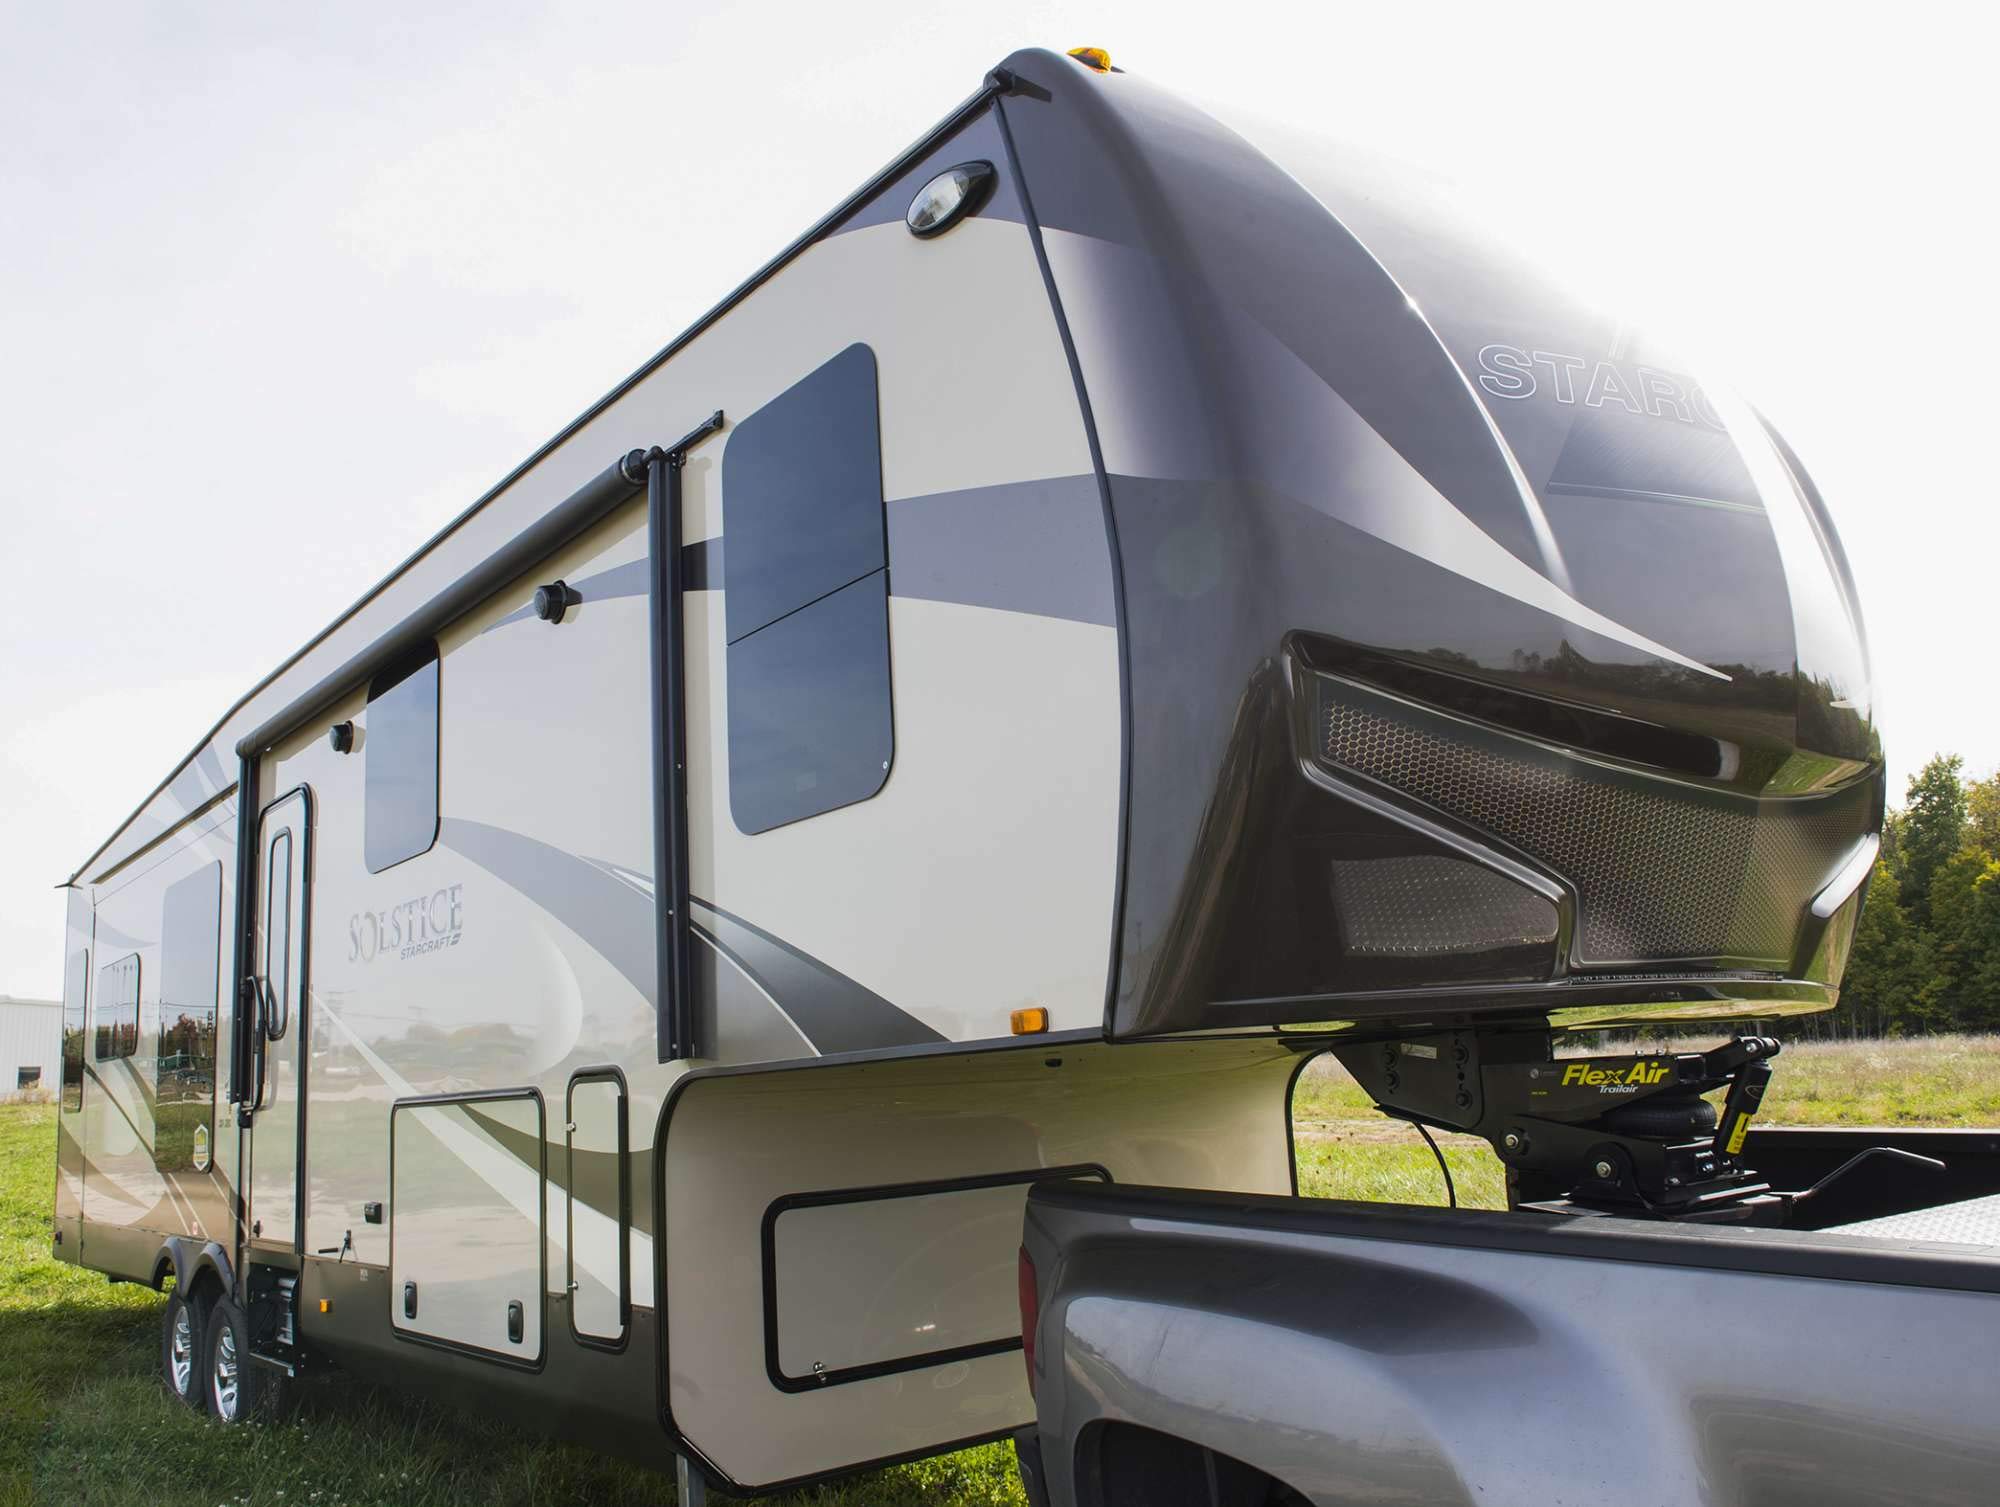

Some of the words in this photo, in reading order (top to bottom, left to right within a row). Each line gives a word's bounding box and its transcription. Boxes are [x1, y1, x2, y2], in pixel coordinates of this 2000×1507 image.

[349, 883, 464, 963] SOLSTICE
[401, 935, 453, 960] STARCRAFT
[1561, 1063, 1625, 1086] Flex
[1625, 1061, 1670, 1084] Air
[1599, 1084, 1639, 1094] Trailair
